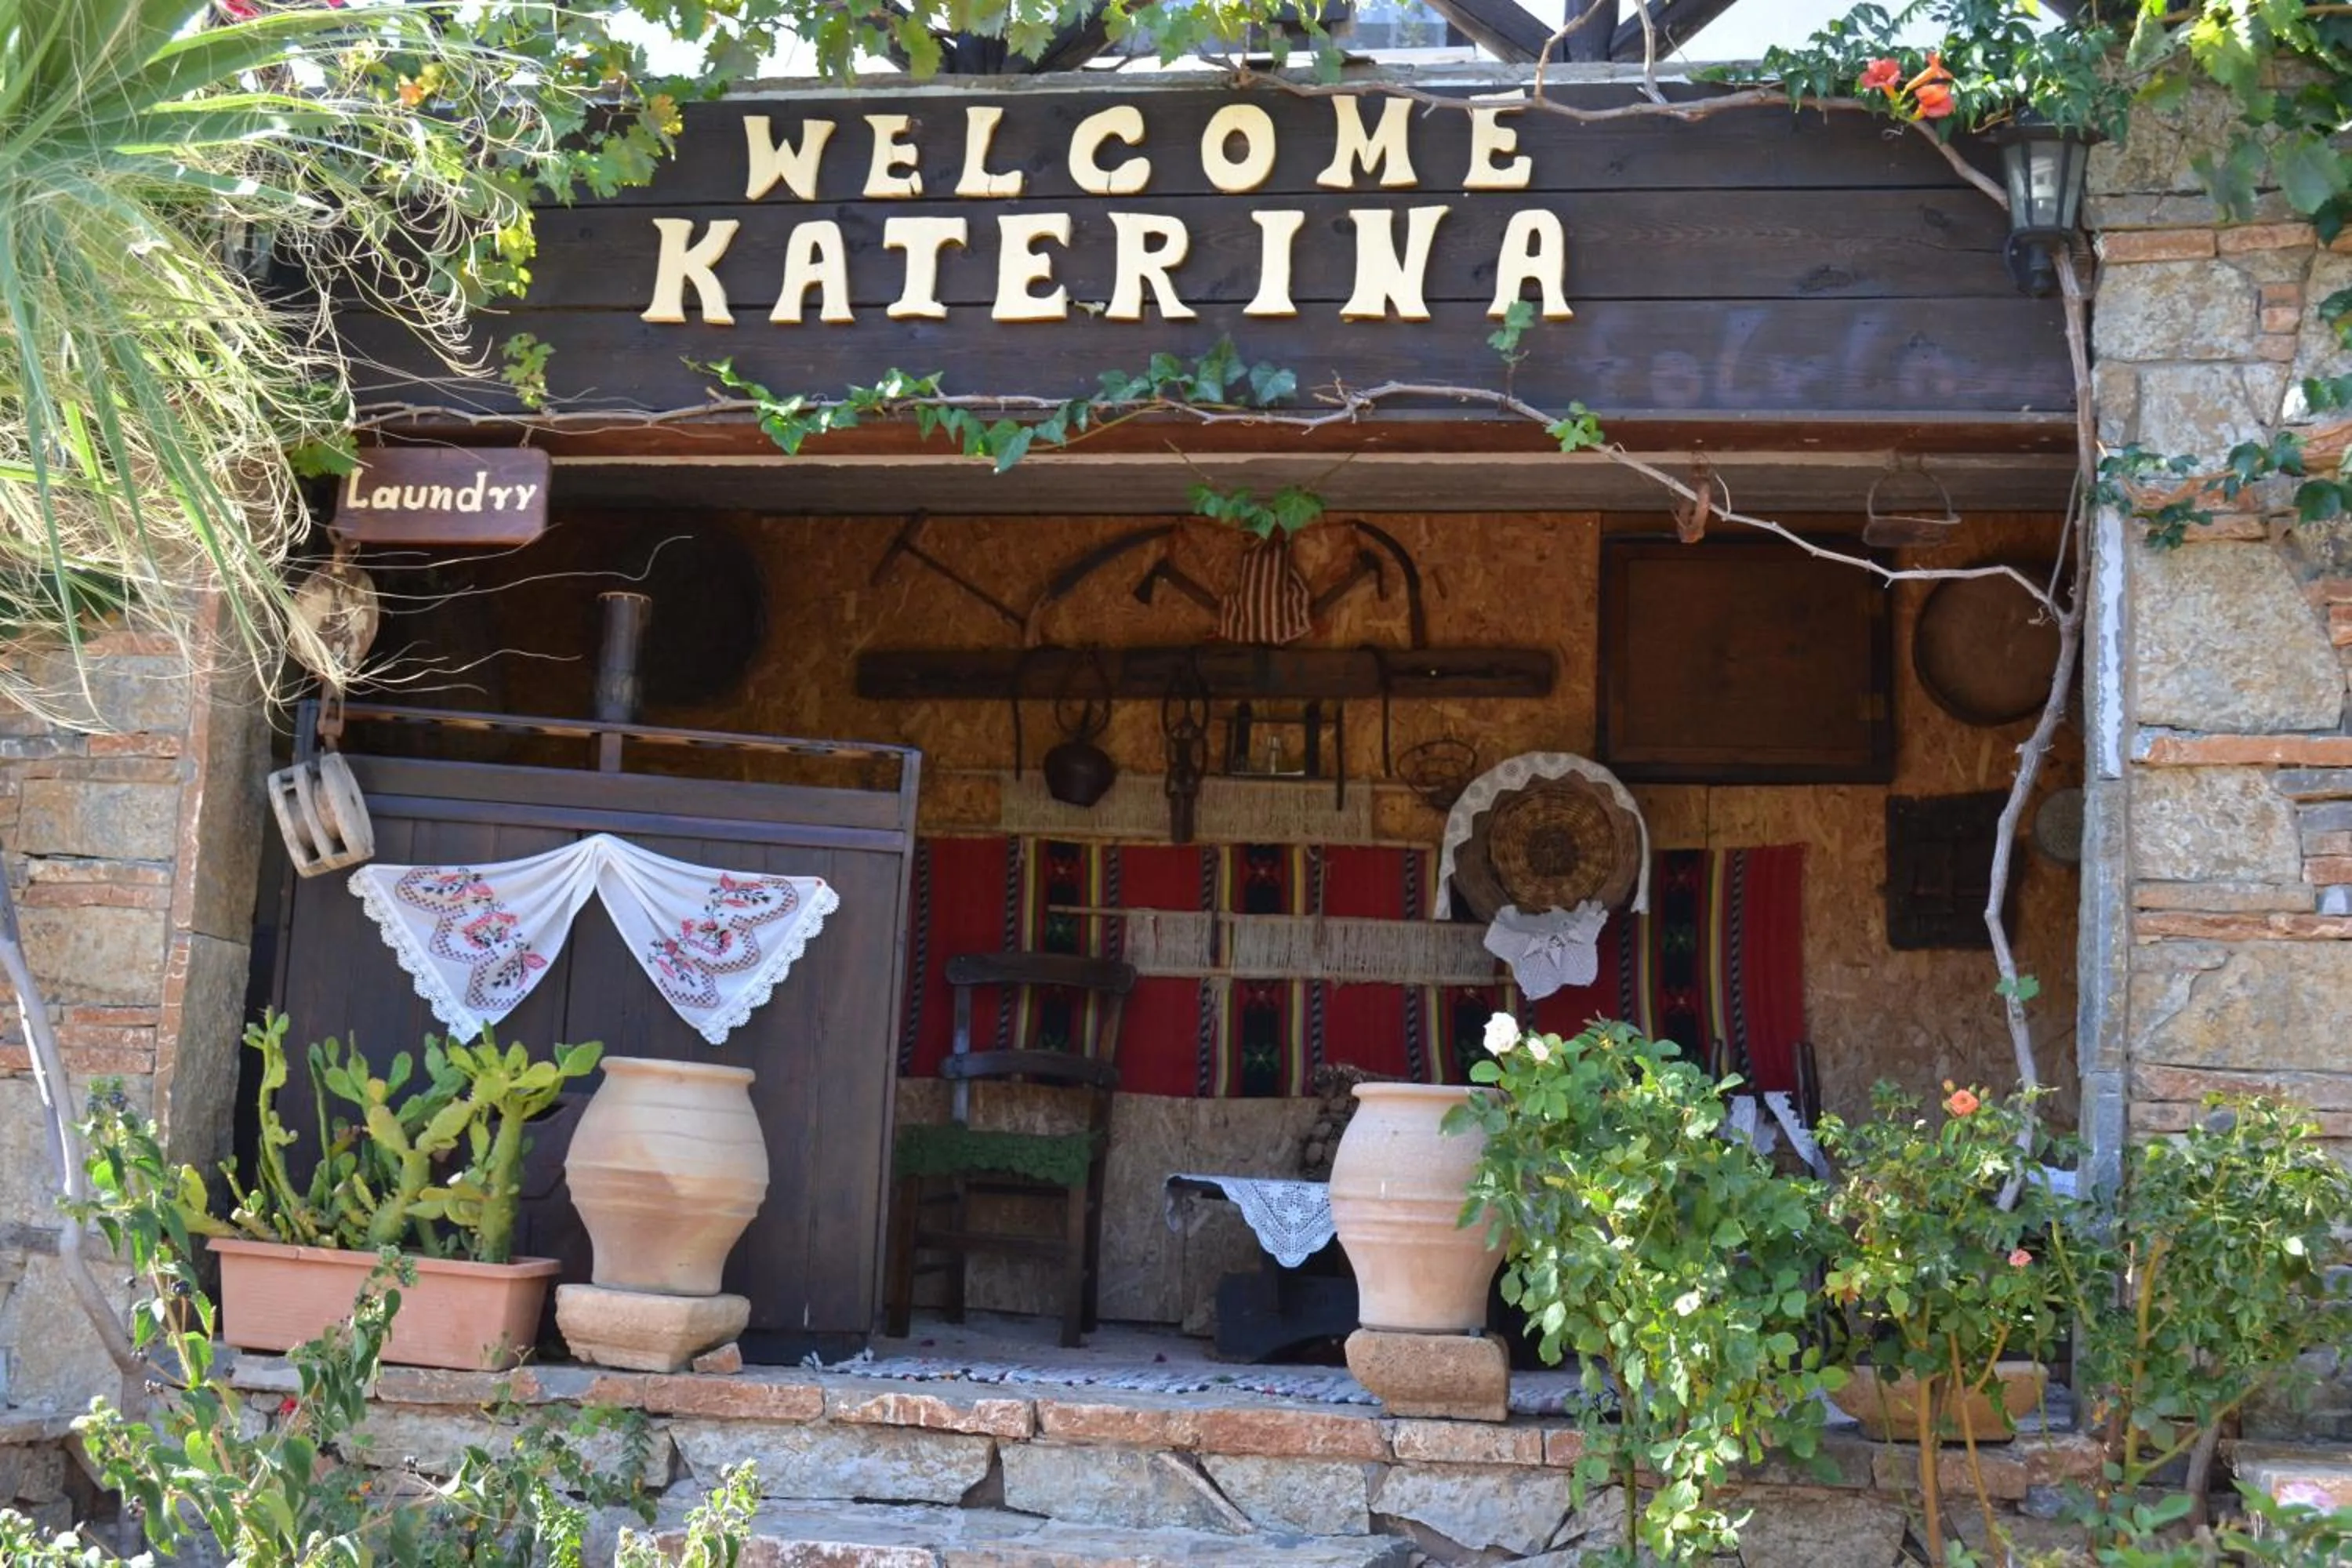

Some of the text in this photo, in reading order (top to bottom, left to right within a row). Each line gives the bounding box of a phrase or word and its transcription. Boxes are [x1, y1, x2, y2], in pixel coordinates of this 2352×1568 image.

[742, 89, 1534, 201] WELCOME
[640, 205, 1574, 326] KATERINA
[346, 466, 539, 513] Laundry
